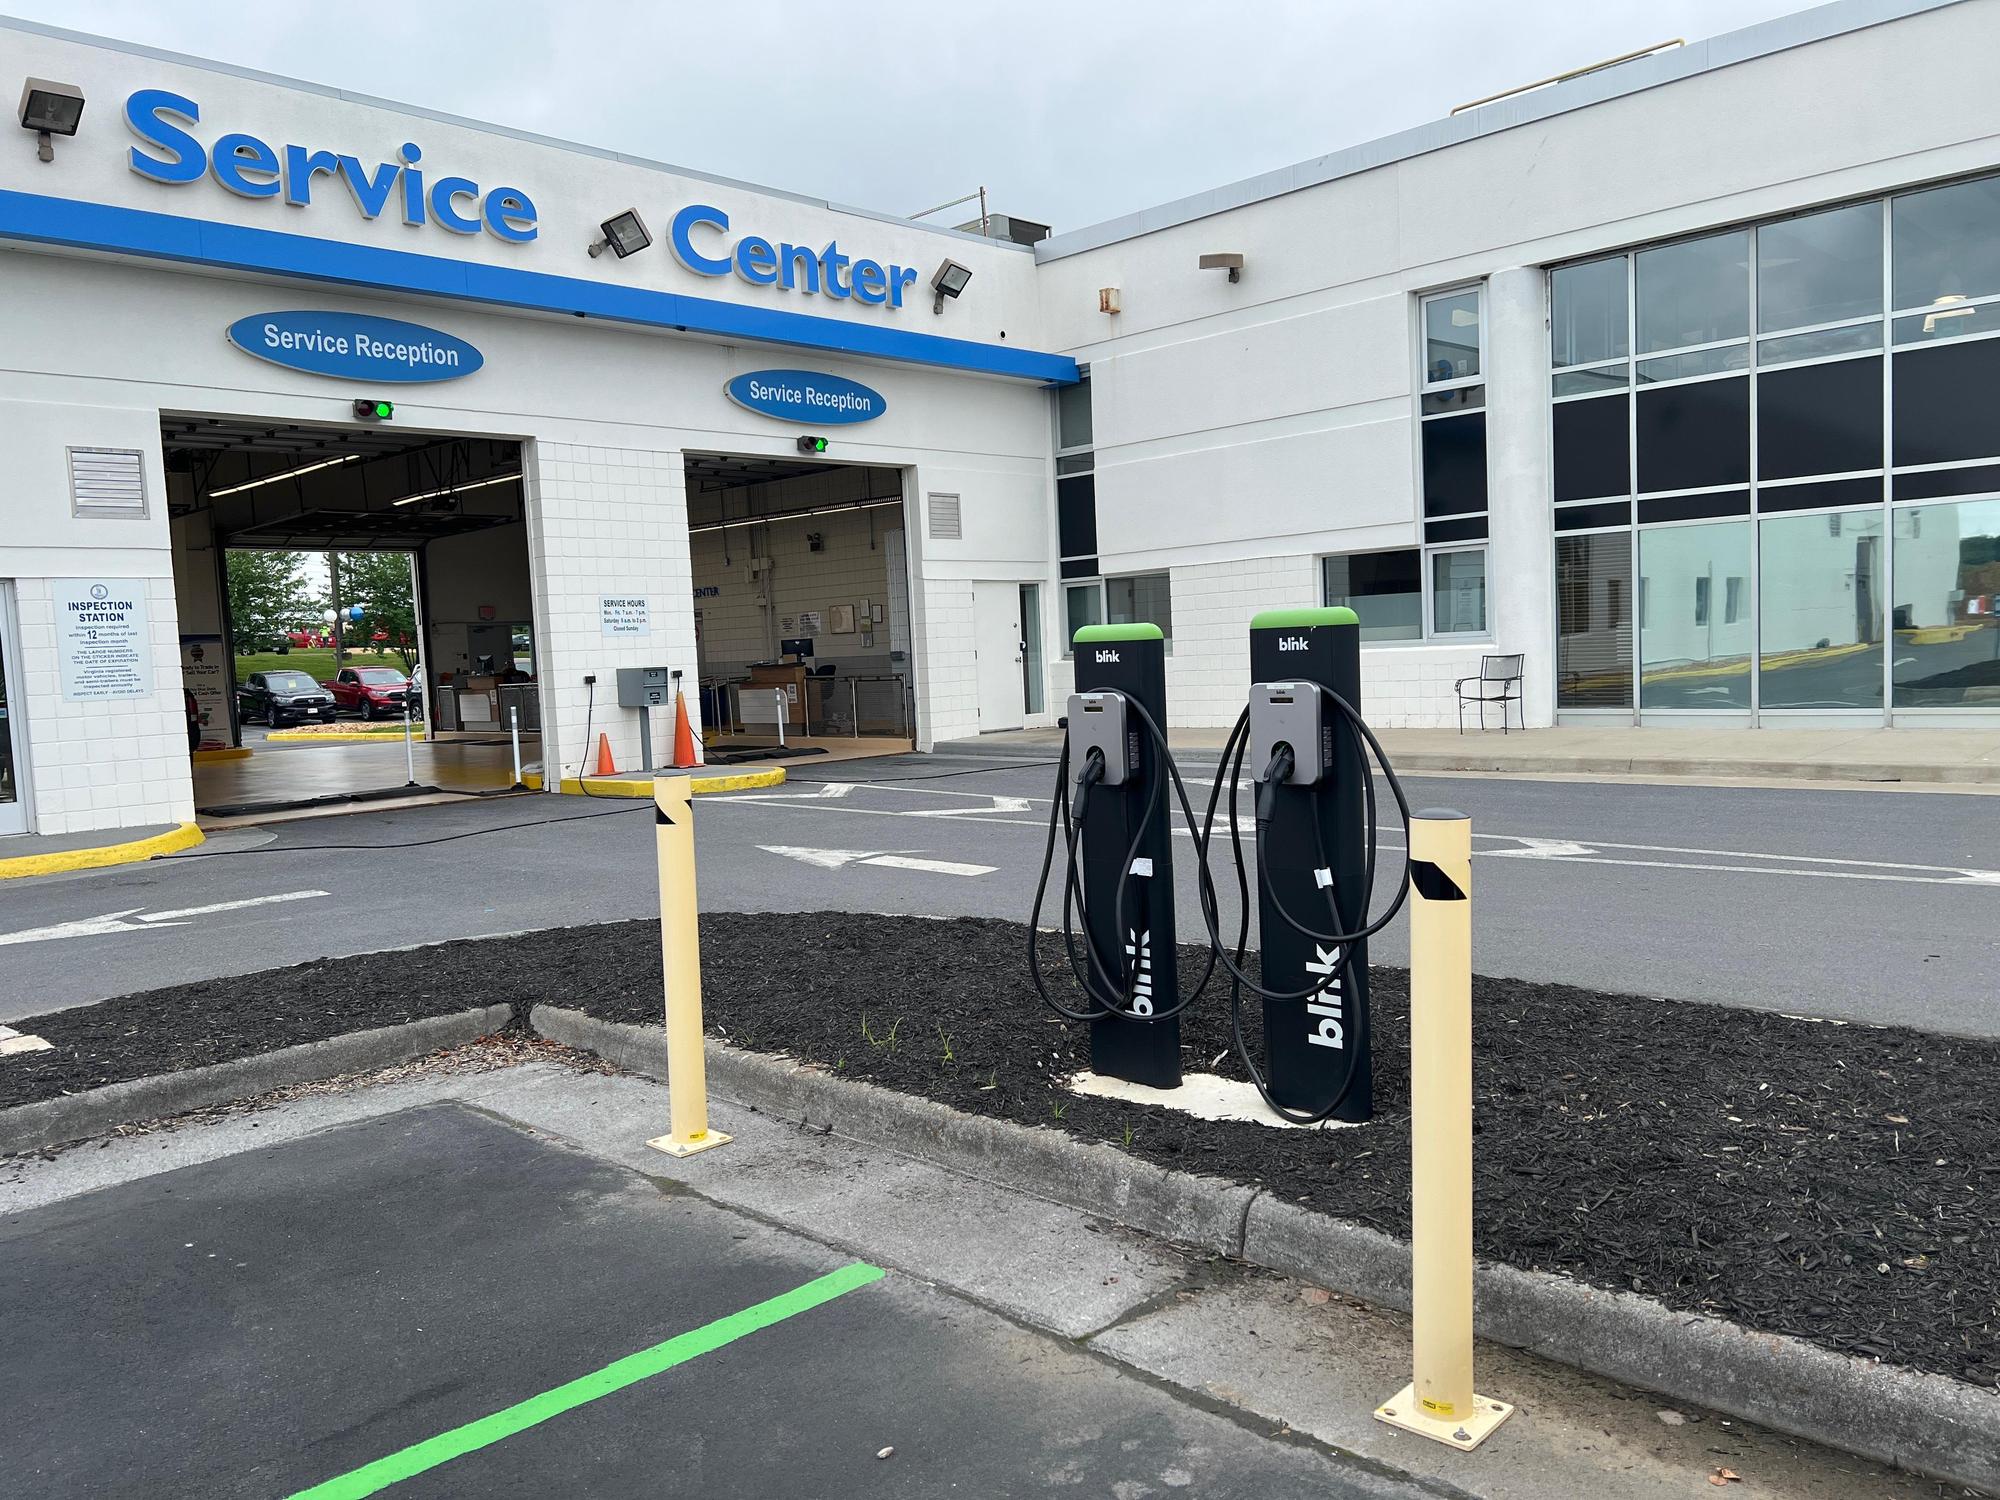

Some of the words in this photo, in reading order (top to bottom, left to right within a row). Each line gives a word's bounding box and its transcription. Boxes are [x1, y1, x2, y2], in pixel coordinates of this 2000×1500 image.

[122, 89, 538, 243] Service
[666, 204, 918, 309] Center
[264, 323, 349, 355] Service
[355, 333, 459, 369] Reception
[750, 380, 802, 404] Service
[806, 387, 871, 413] Reception
[68, 601, 133, 611] INSPECTION
[603, 599, 626, 607] SERVICE
[627, 599, 645, 607] HOURS
[79, 613, 124, 622] STATION
[87, 630, 97, 639] 12
[1279, 637, 1309, 651] blink
[1095, 650, 1120, 663] blink
[1306, 944, 1344, 1049] blink
